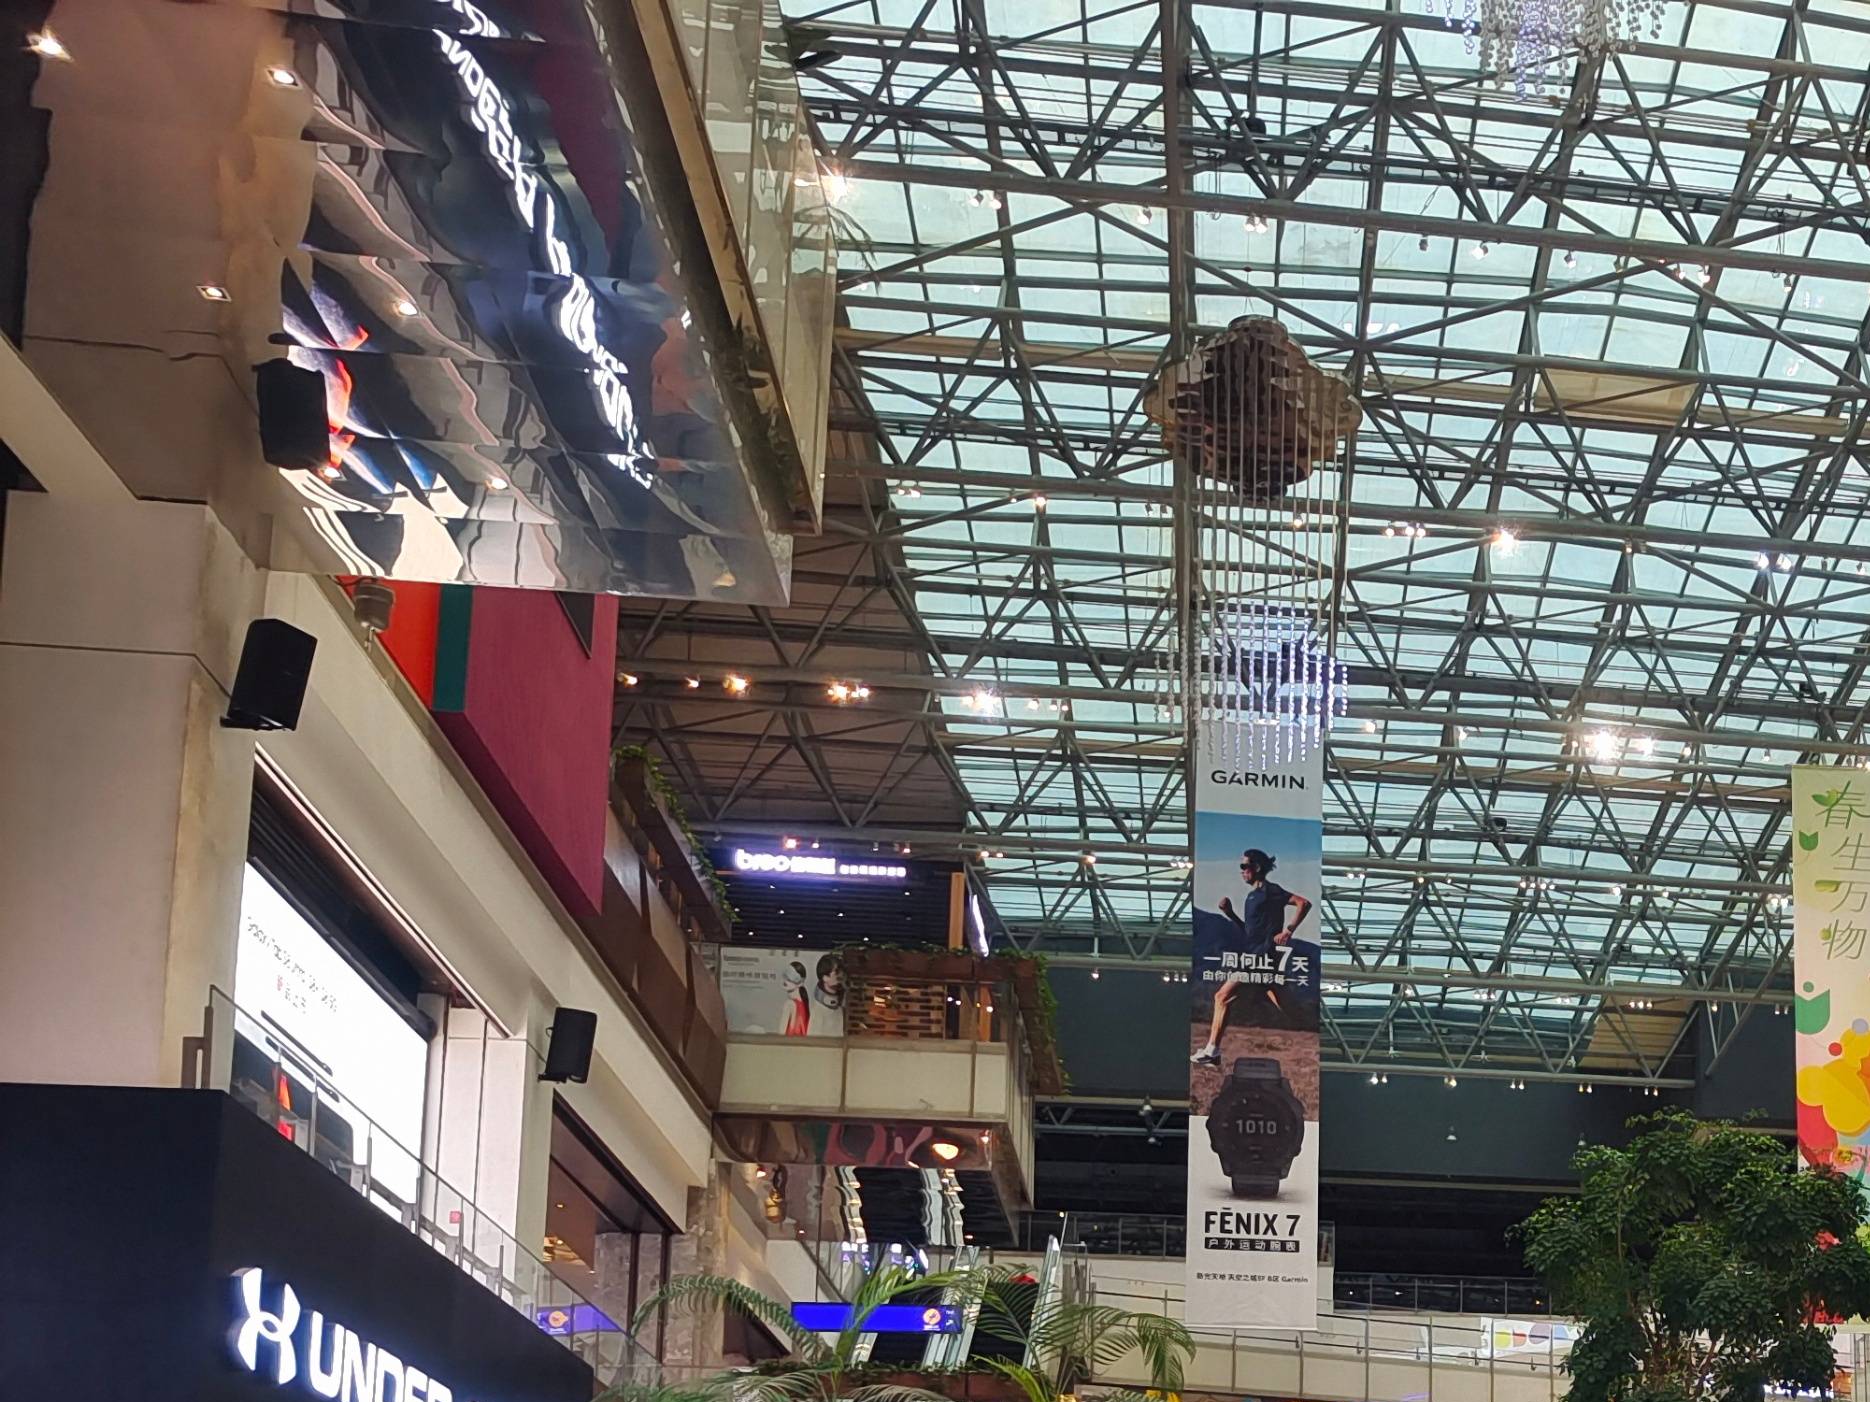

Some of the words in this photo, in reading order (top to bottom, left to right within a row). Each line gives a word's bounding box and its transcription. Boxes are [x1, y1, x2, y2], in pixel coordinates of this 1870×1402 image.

[1211, 770, 1305, 789] GARMIN
[1202, 945, 1309, 973] 一周何止7天
[1235, 1119, 1277, 1135] 1010
[1286, 1214, 1301, 1237] 7
